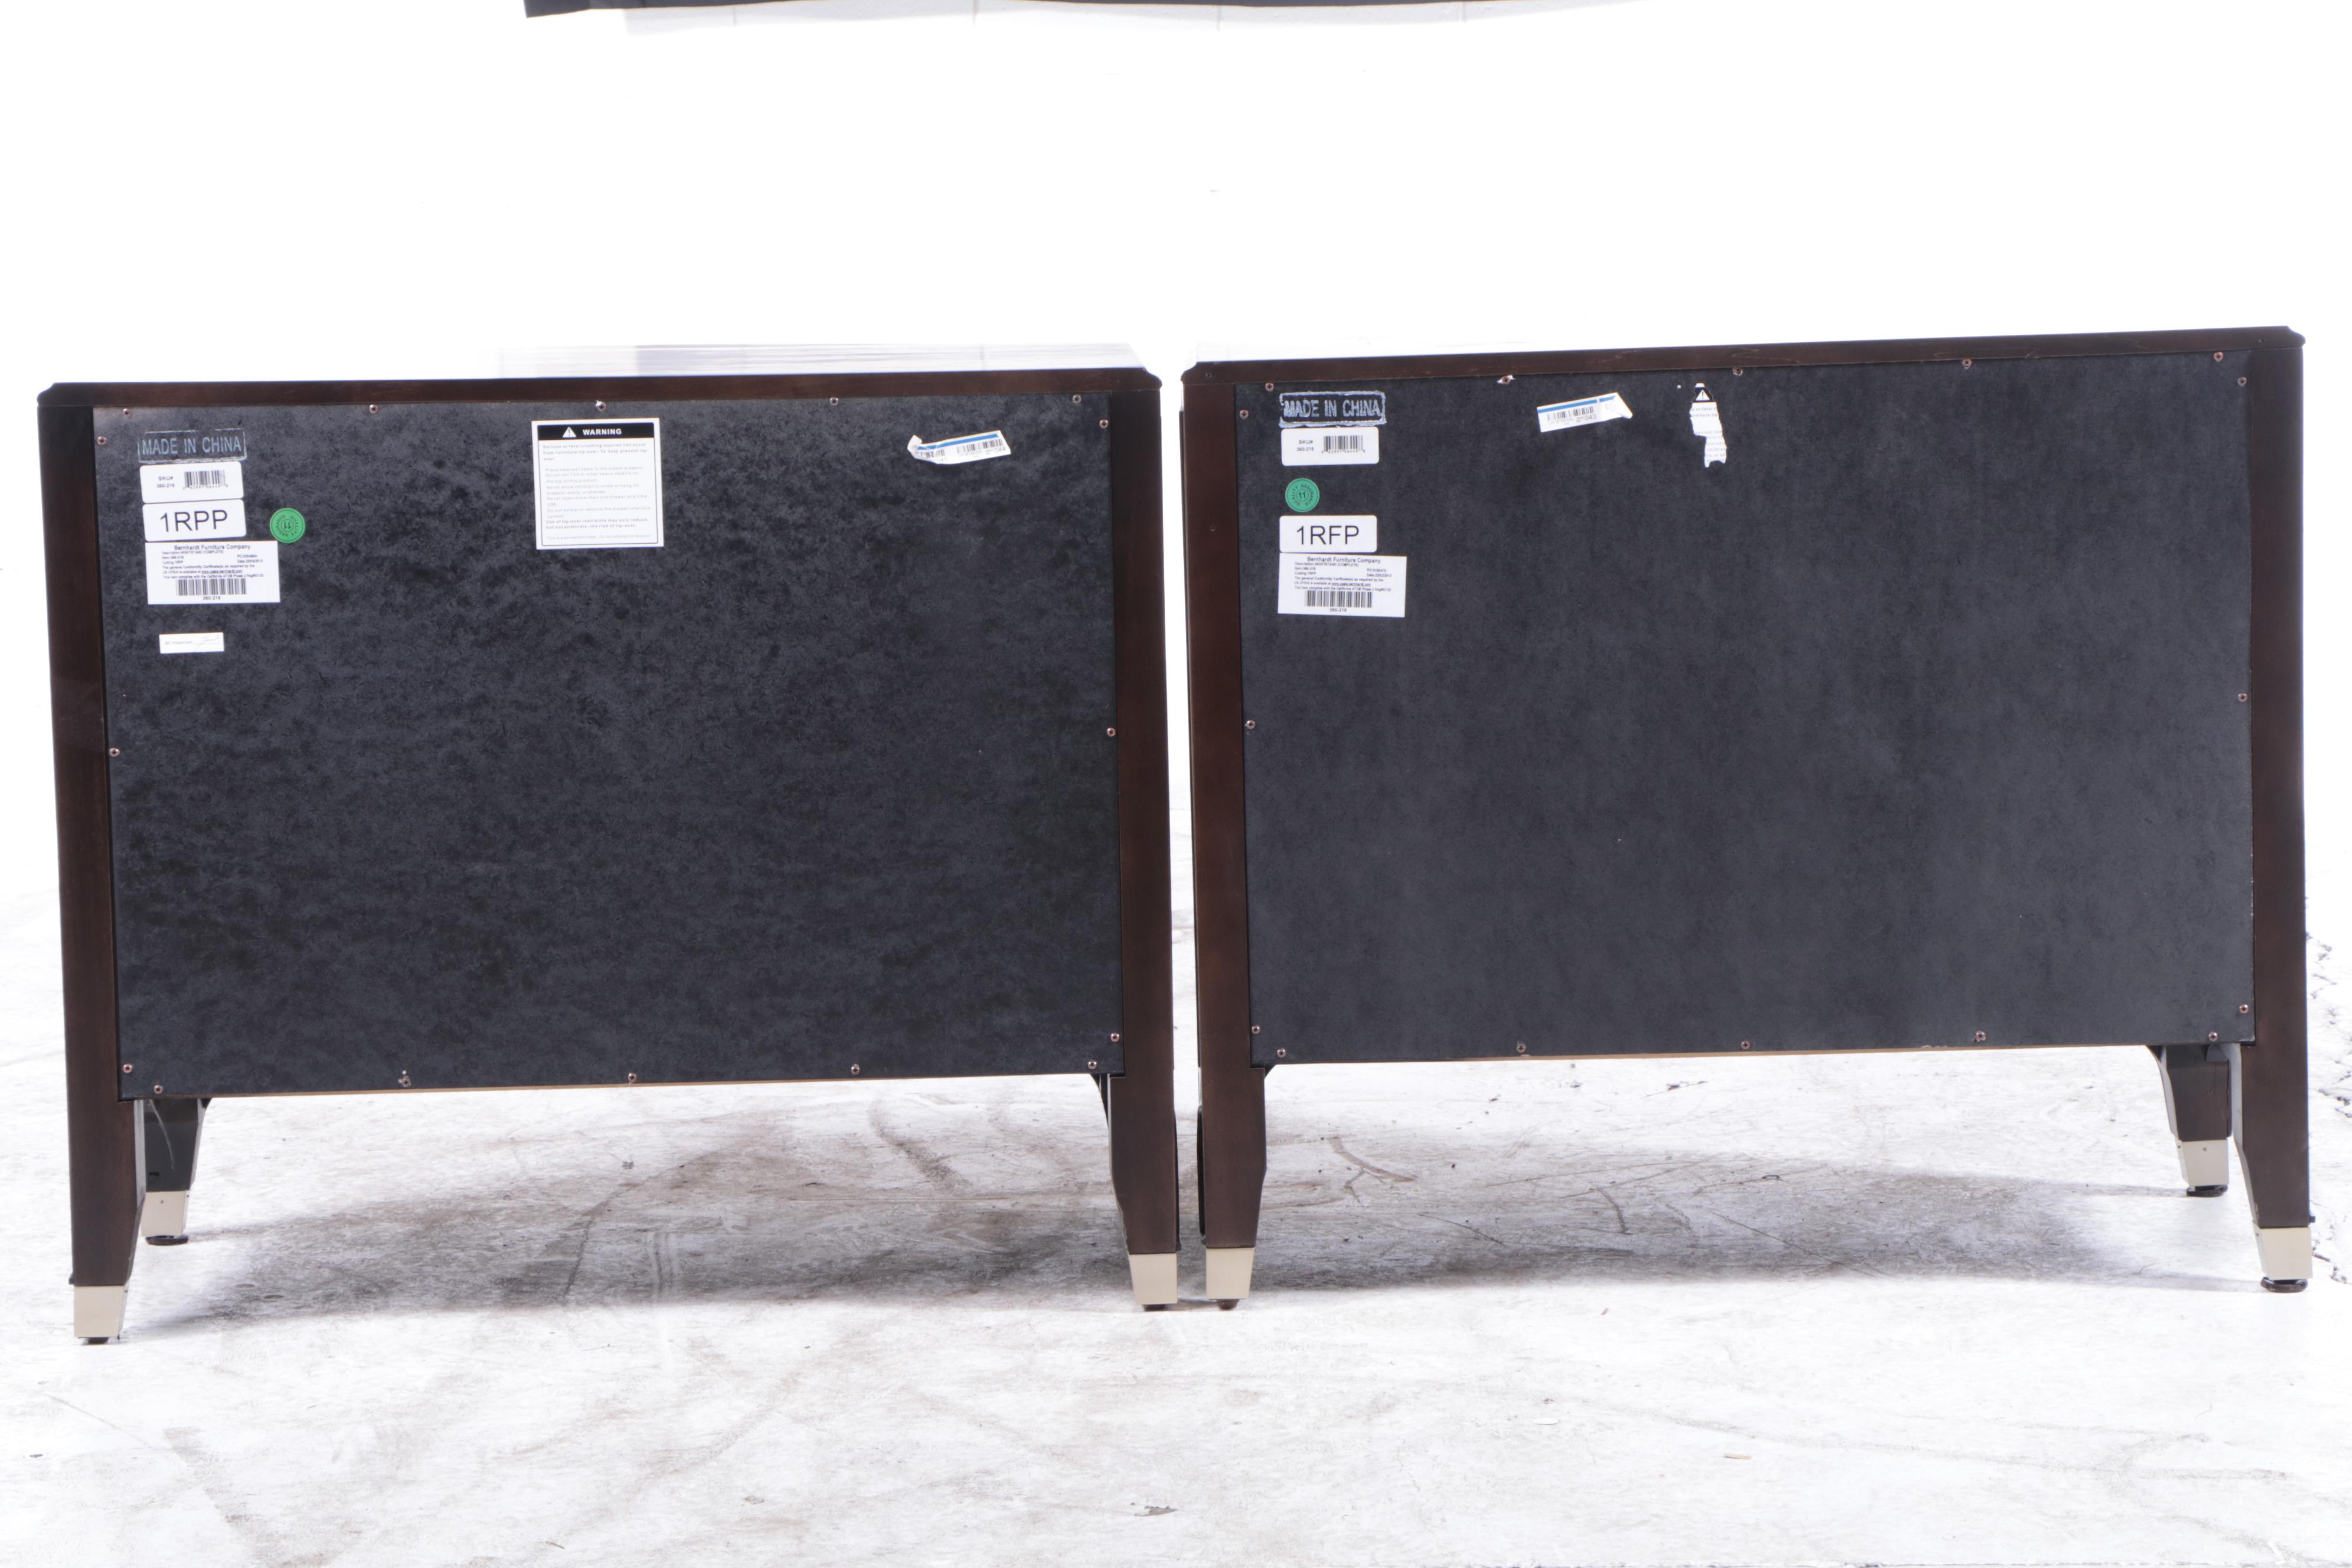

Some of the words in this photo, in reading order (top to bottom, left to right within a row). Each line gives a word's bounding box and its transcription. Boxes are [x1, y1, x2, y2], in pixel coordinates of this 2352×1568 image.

[1284, 400, 1319, 417] MADE
[1324, 400, 1337, 417] IN
[1342, 399, 1381, 417] CHINA
[142, 438, 178, 455] MADE
[184, 438, 196, 453] IN
[202, 436, 241, 453] CHINA
[160, 510, 228, 532] 1RPP
[1297, 525, 1359, 545] 1RFP
